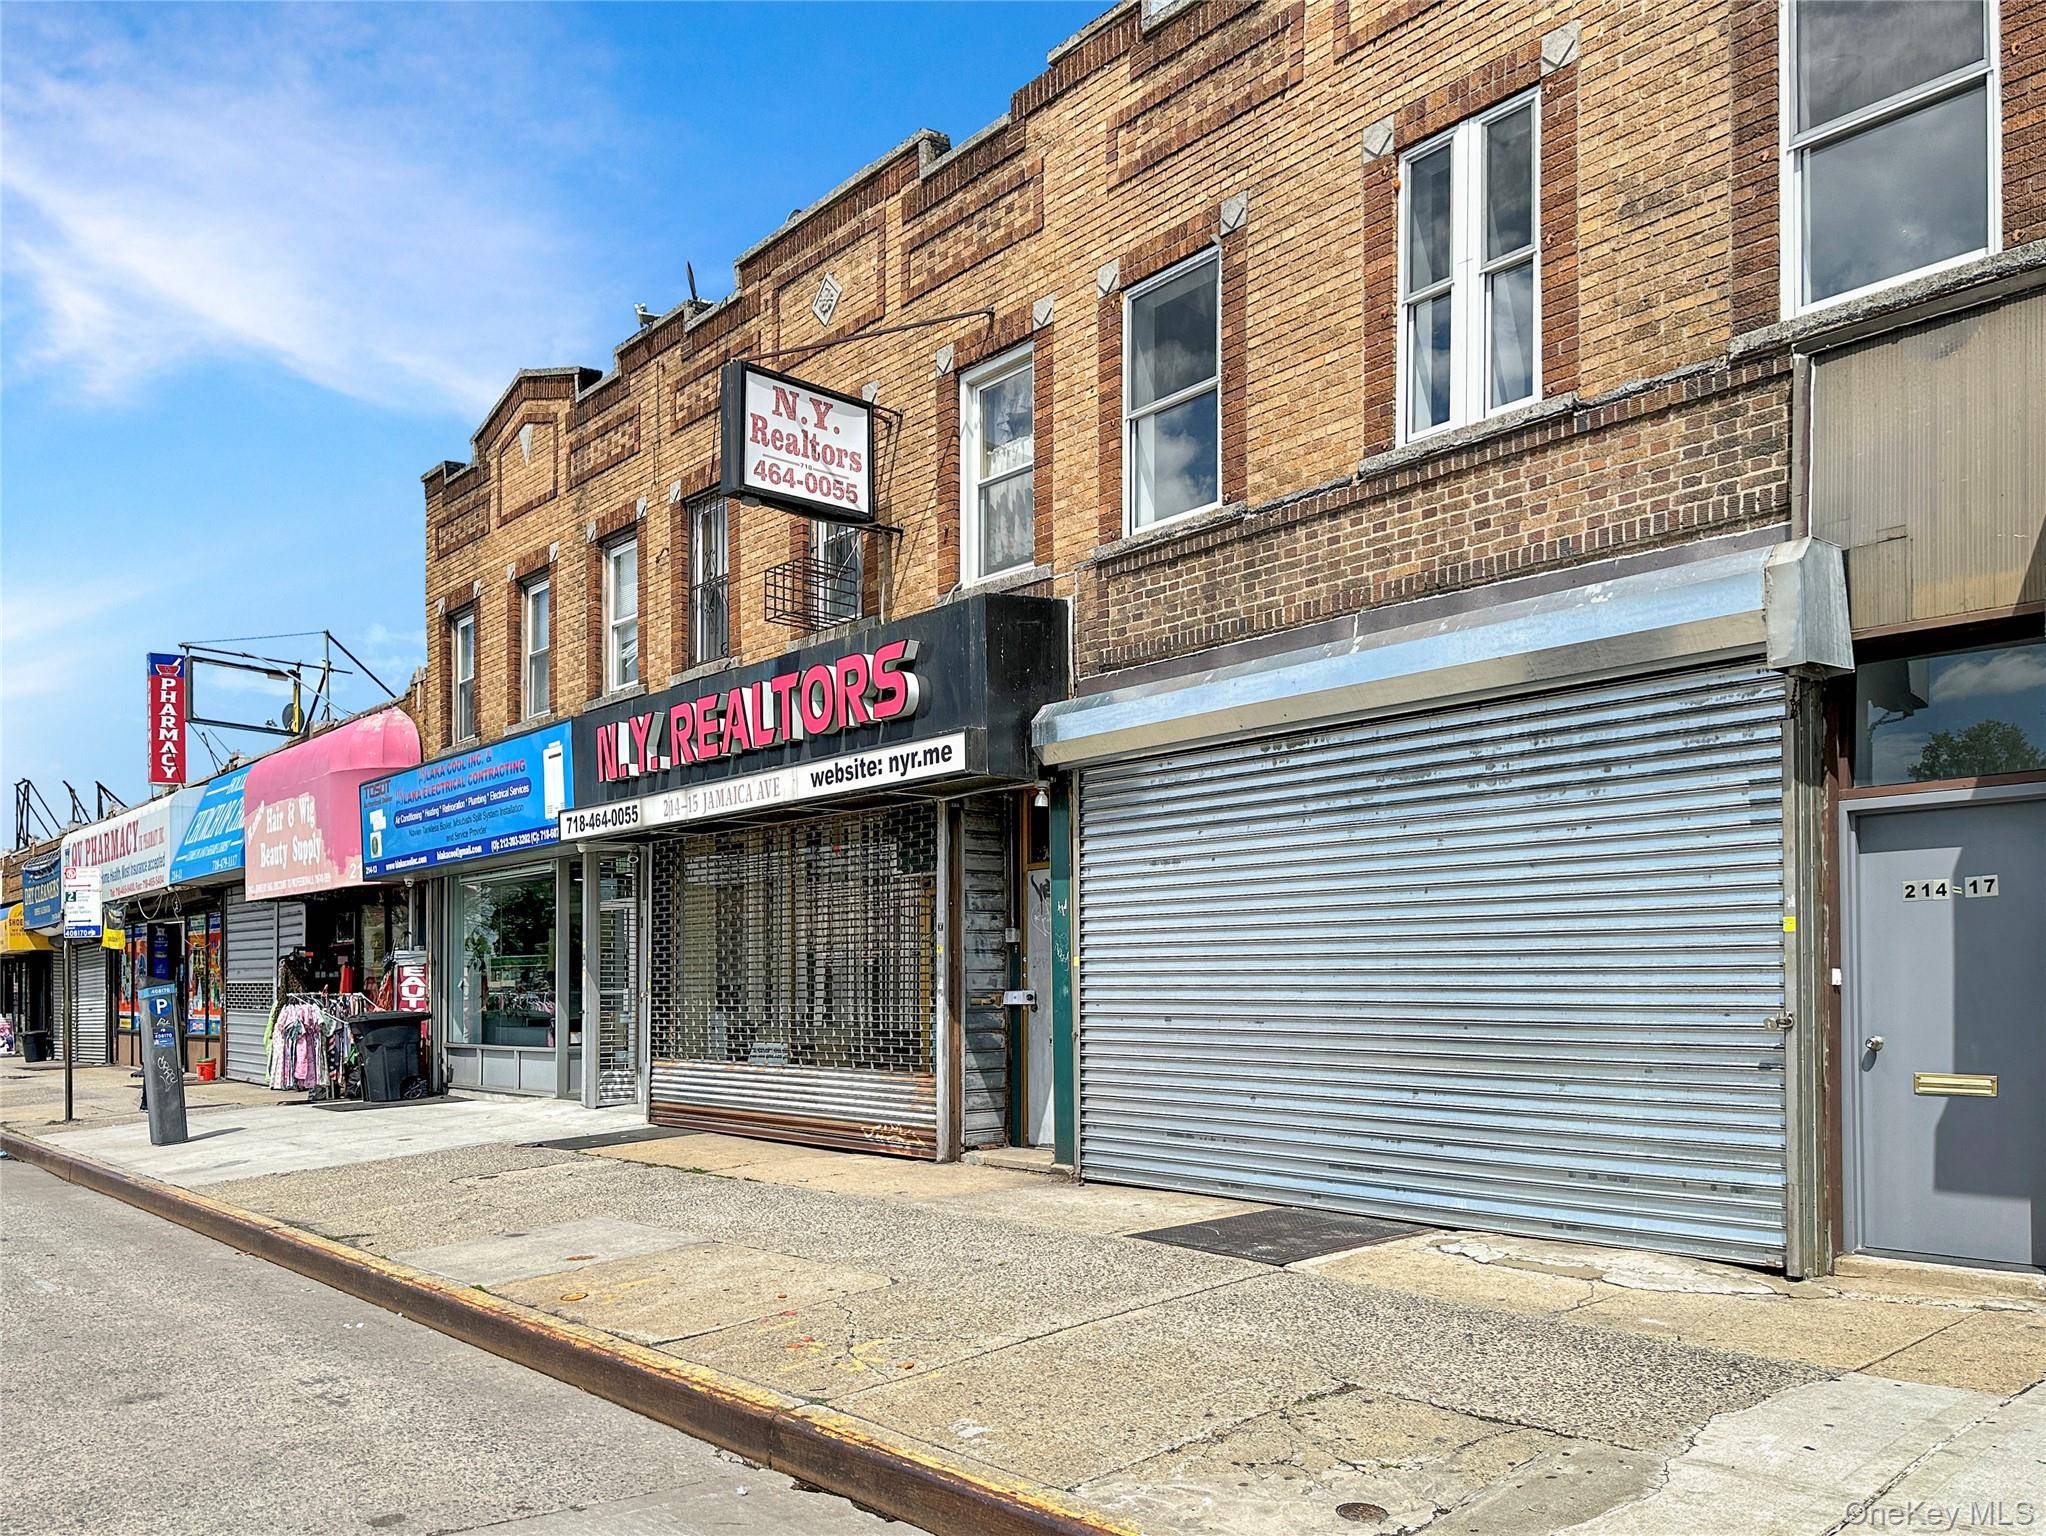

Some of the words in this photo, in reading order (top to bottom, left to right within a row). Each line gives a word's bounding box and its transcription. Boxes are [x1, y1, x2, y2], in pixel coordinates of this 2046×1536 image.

[771, 385, 841, 436] N.Y.
[750, 412, 863, 473] Realtors
[753, 459, 859, 504] 464-0055
[158, 677, 180, 779] PHARMACY
[596, 712, 665, 783] N.Y.
[669, 639, 915, 767] REALTORS
[423, 776, 466, 799] ELECTRICAL
[467, 759, 527, 786] CONTRACTING
[810, 757, 883, 788] website:
[888, 744, 953, 777] nyr.me
[265, 805, 284, 835] Hair
[298, 796, 317, 830] Wig
[663, 793, 699, 818] 214-15
[702, 783, 753, 814] JAMAICA
[757, 777, 781, 801] AVE
[566, 804, 639, 834] 718-464-0055
[85, 820, 140, 867] PHARMACY
[260, 840, 289, 871] Beauty
[292, 830, 322, 867] Supply
[67, 892, 75, 901] 2
[1904, 878, 1996, 899] 214-17
[155, 998, 168, 1016] P
